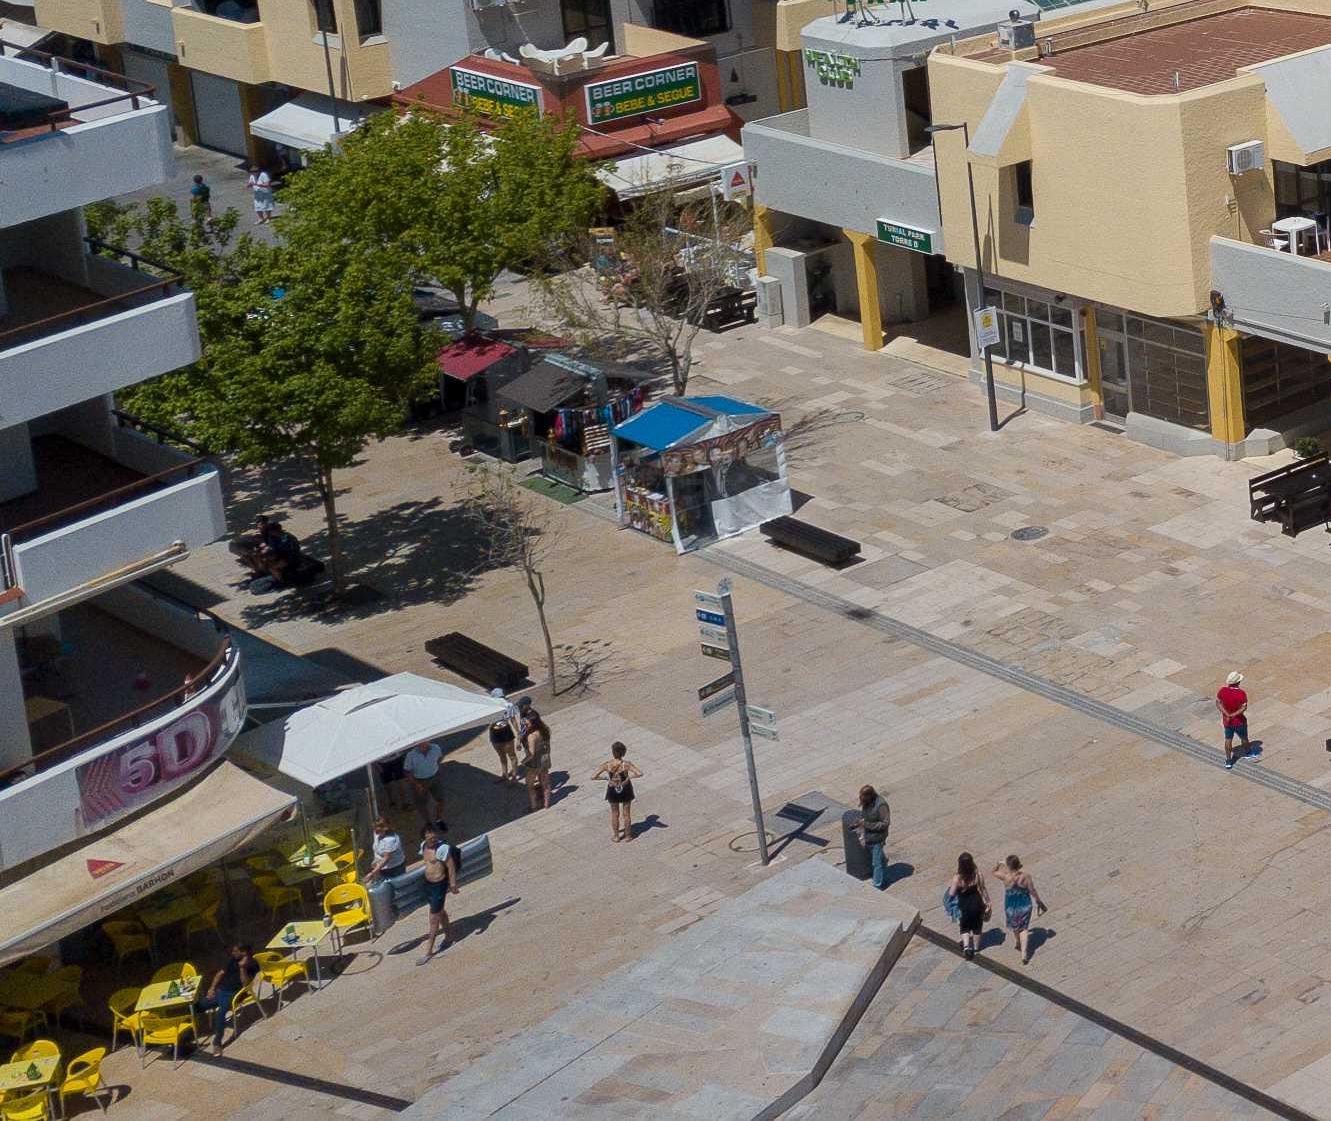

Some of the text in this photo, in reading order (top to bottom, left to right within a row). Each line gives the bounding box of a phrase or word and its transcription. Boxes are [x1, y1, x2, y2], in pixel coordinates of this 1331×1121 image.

[455, 71, 535, 103] BEER CORNER
[592, 66, 696, 100] BEER CORNER
[615, 85, 694, 113] BEBE & SEGUE
